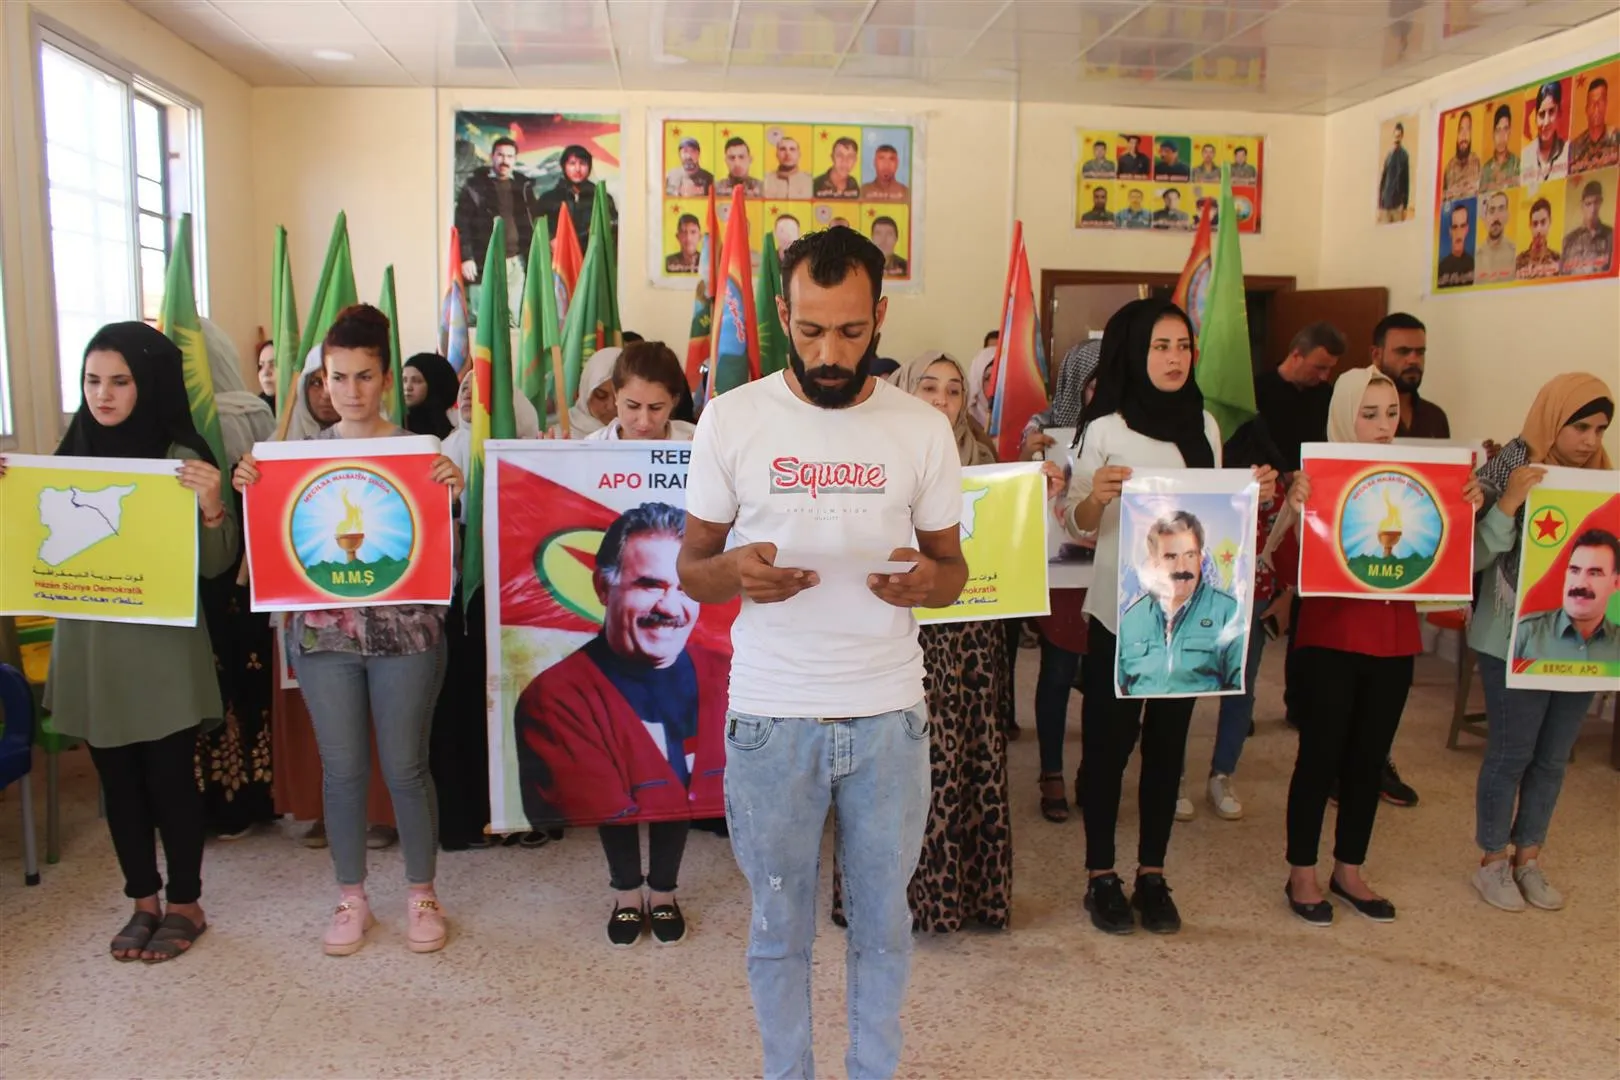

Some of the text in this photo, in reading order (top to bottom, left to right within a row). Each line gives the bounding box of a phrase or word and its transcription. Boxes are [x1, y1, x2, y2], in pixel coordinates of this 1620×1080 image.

[598, 473, 688, 489] APO IRA
[772, 456, 888, 499] Square
[331, 570, 375, 586] M.M.Ş
[1367, 564, 1404, 580] M.M.Ş
[1580, 664, 1598, 675] APO
